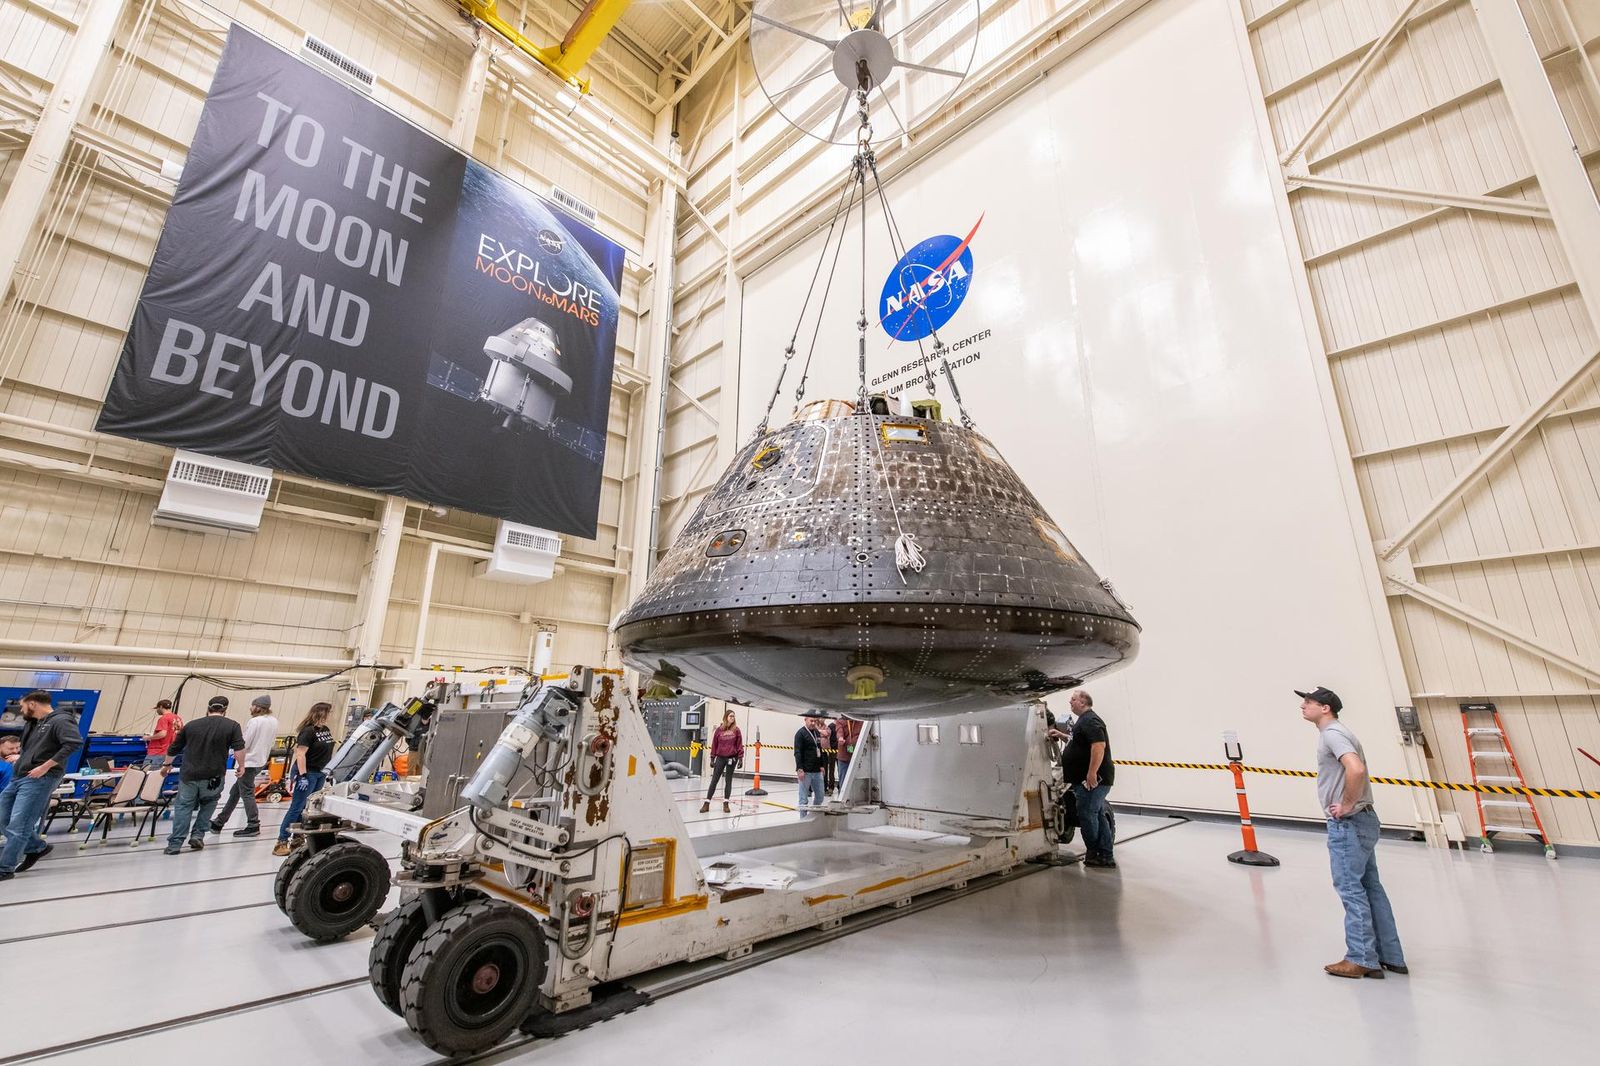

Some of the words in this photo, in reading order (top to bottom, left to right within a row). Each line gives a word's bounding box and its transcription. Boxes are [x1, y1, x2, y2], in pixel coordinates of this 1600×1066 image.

[257, 91, 325, 168] TO
[342, 136, 431, 224] THE
[233, 168, 409, 287] MOON
[237, 261, 370, 347] AND
[478, 233, 602, 313] EXPLORE
[886, 260, 968, 316] NASA
[150, 318, 400, 439] BEYOND
[871, 369, 899, 386] GLENN
[901, 346, 950, 374] RESEARCH
[953, 329, 992, 352] CENTER
[906, 370, 938, 389] BROOK
[940, 352, 981, 375] SATION
